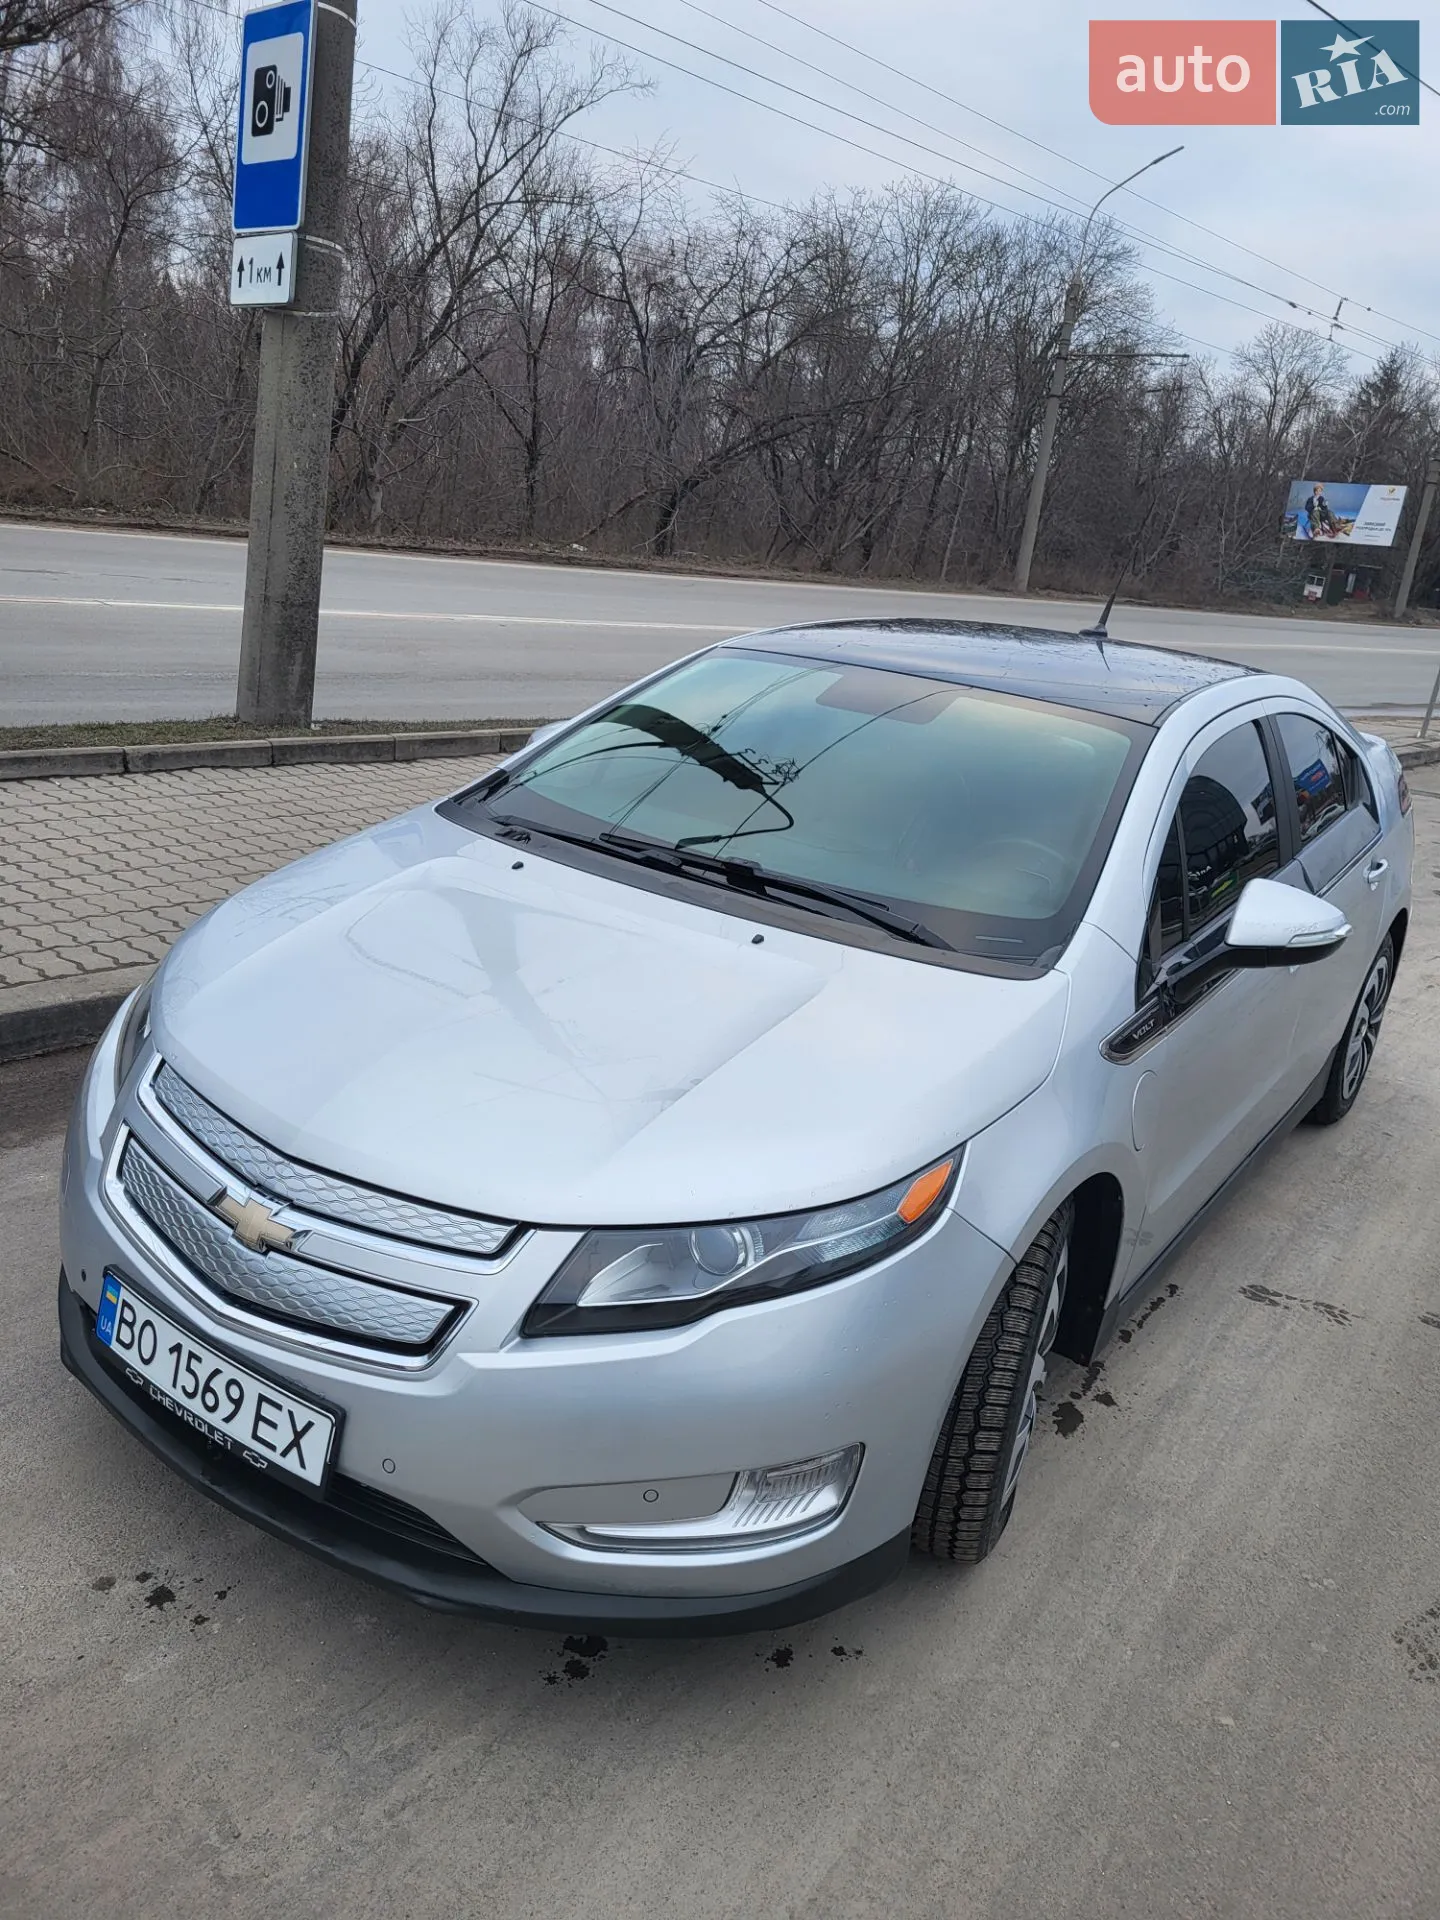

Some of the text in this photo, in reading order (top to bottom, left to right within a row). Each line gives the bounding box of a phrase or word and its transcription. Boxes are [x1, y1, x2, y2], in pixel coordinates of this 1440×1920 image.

[248, 256, 254, 284] 1
[1132, 1018, 1155, 1040] VOLT
[100, 1315, 112, 1336] UA
[115, 1297, 315, 1470] BO 1569 EX
[149, 1386, 235, 1450] CHEVROLET
